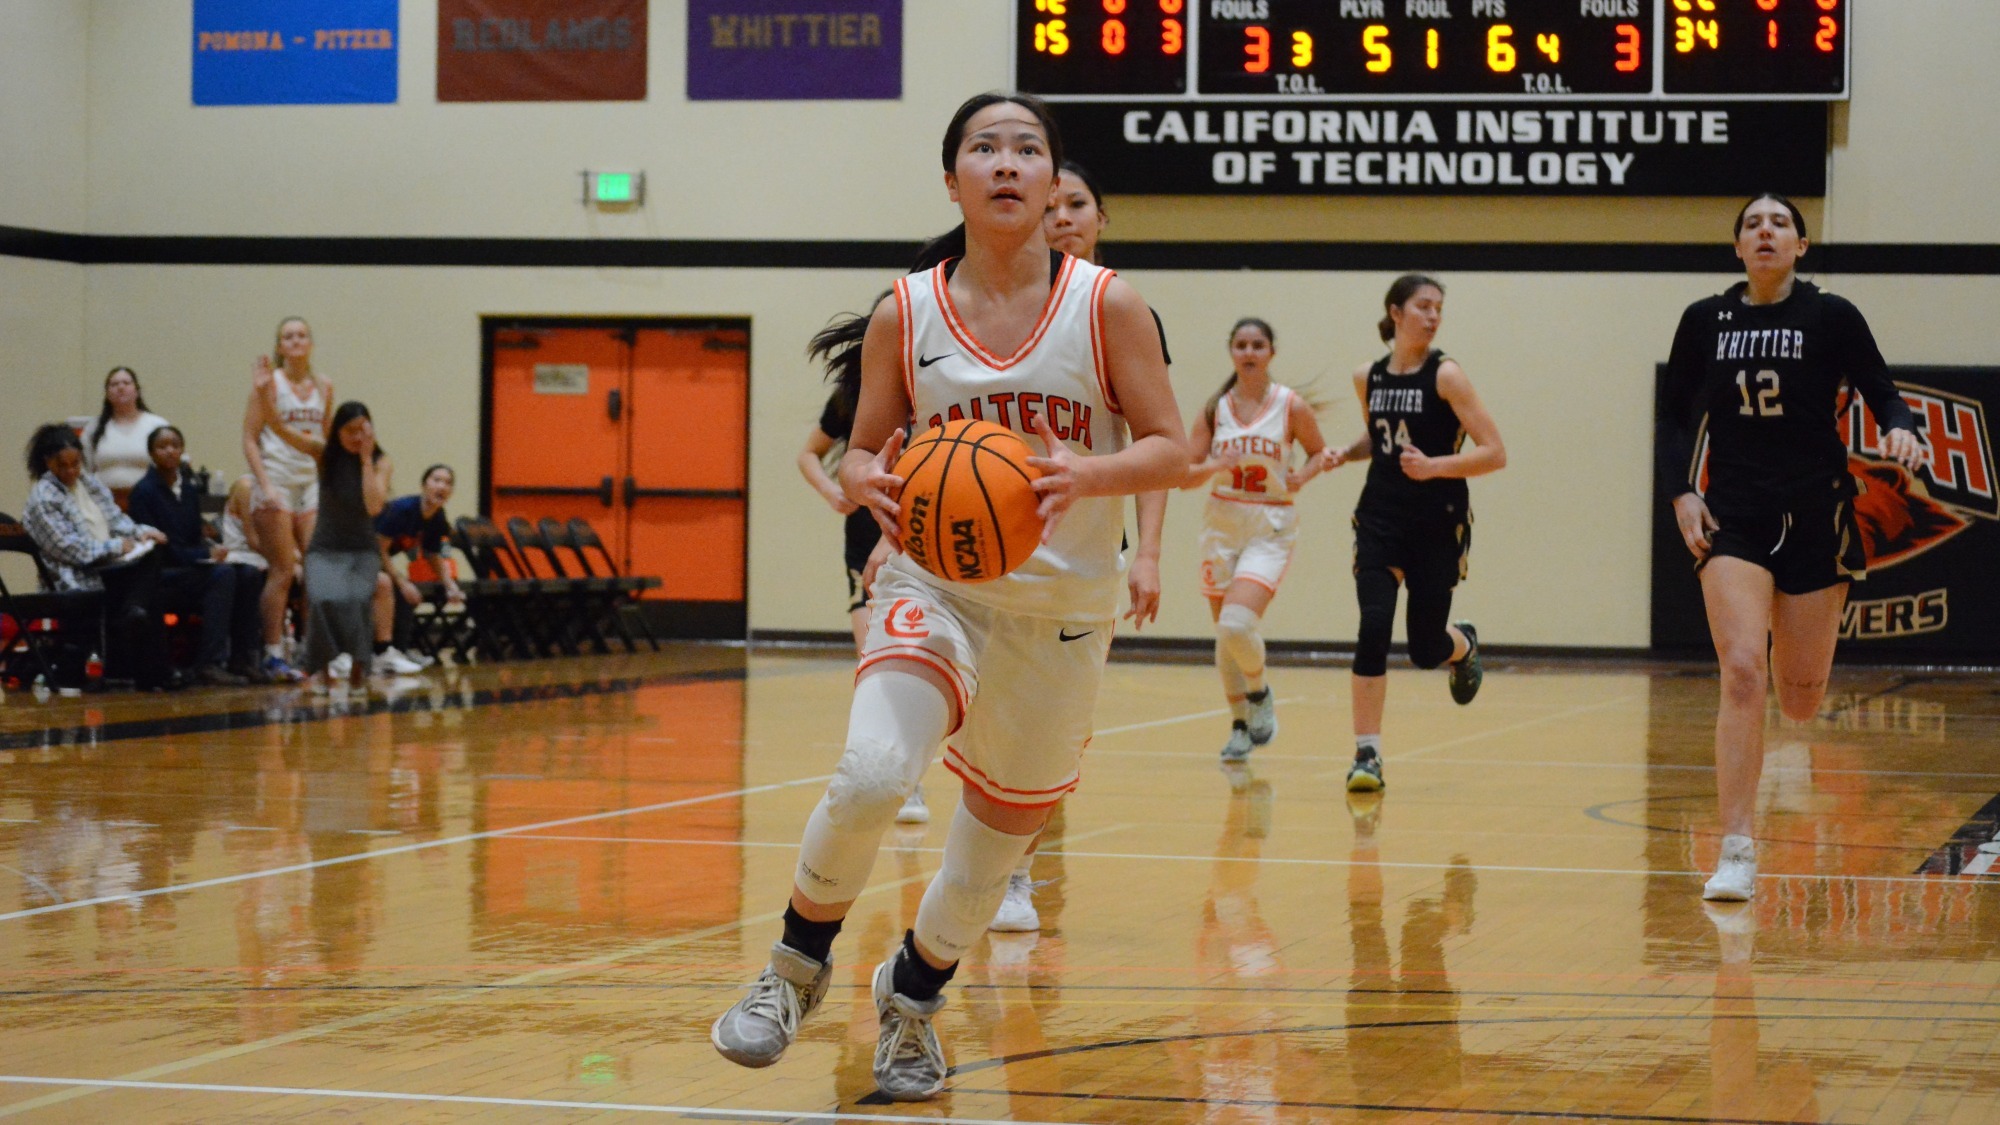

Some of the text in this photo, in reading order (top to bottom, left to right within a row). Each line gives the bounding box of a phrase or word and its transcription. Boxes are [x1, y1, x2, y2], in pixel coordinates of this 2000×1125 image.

[1211, 0, 1269, 19] FOULS
[1340, 0, 1384, 18] PLYR
[1406, 0, 1452, 18] FOUL
[1472, 0, 1505, 18] PTS
[1580, 0, 1640, 17] FOULS
[199, 31, 284, 51] POMONA
[313, 29, 392, 49] PITZER
[452, 16, 633, 51] REDLANDS
[708, 13, 881, 48] WHITTIER
[1035, 19, 1069, 55] 15
[1102, 19, 1125, 54] 0
[1162, 19, 1182, 54] 3
[1615, 24, 1640, 71] 3
[1675, 16, 1718, 52] 34
[1768, 19, 1777, 48] 1
[1815, 16, 1836, 51] 2
[1244, 26, 1269, 72] 3
[1292, 31, 1312, 67] 3
[1363, 25, 1391, 72] 5
[1426, 28, 1438, 69] 1
[1487, 25, 1516, 72] 6
[1537, 34, 1559, 63] 4
[1123, 110, 1729, 143] CALIFORNIA INSTITUTE
[1212, 151, 1634, 184] OF TECHNOLOGY
[1716, 328, 1804, 360] WHITTIER
[1736, 369, 1784, 416] 12
[1375, 418, 1412, 453] 34
[1232, 465, 1267, 492] 12
[951, 519, 984, 579] NCAA
[1838, 587, 1948, 639] VERS
